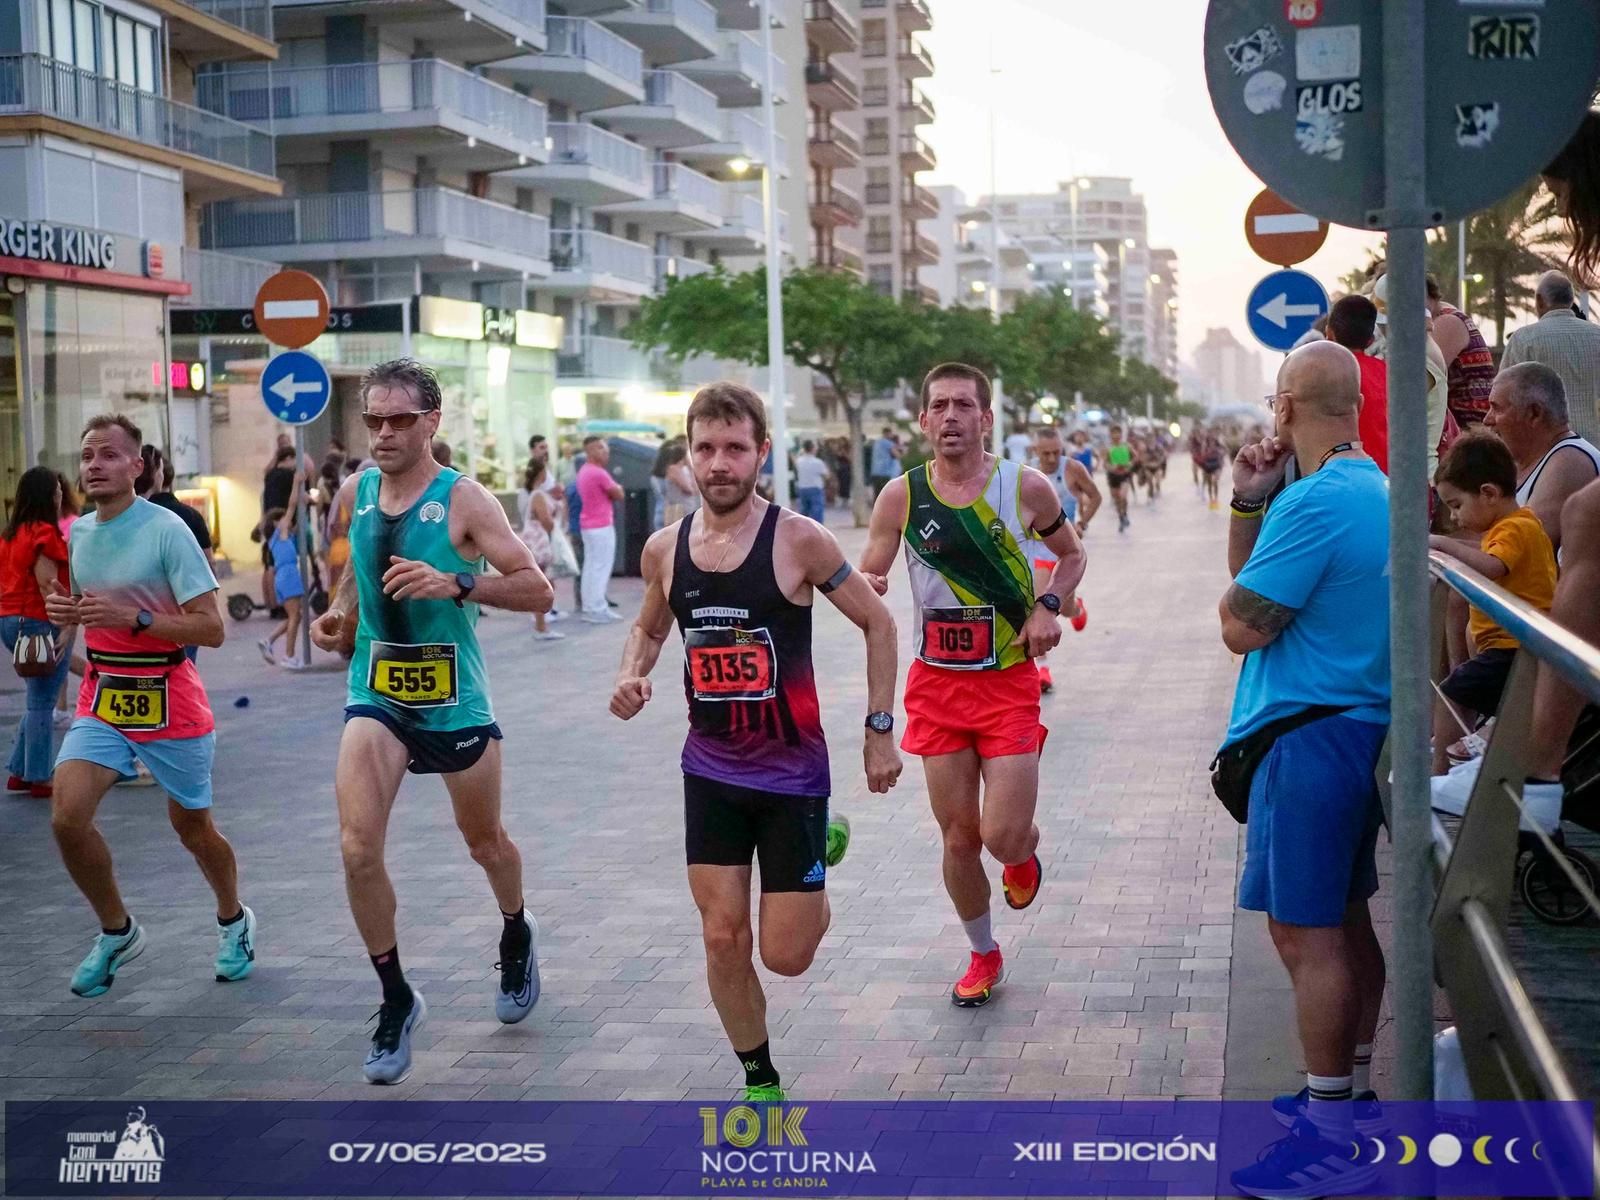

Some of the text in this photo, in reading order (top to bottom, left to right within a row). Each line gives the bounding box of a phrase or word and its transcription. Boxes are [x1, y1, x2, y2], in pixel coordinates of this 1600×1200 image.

[1288, 5, 1318, 21] NO
[1298, 82, 1361, 114] GLOS
[61, 228, 116, 270] KING
[937, 626, 974, 652] 109
[387, 665, 437, 693] 555
[698, 652, 758, 682] 3135
[109, 693, 151, 718] 438
